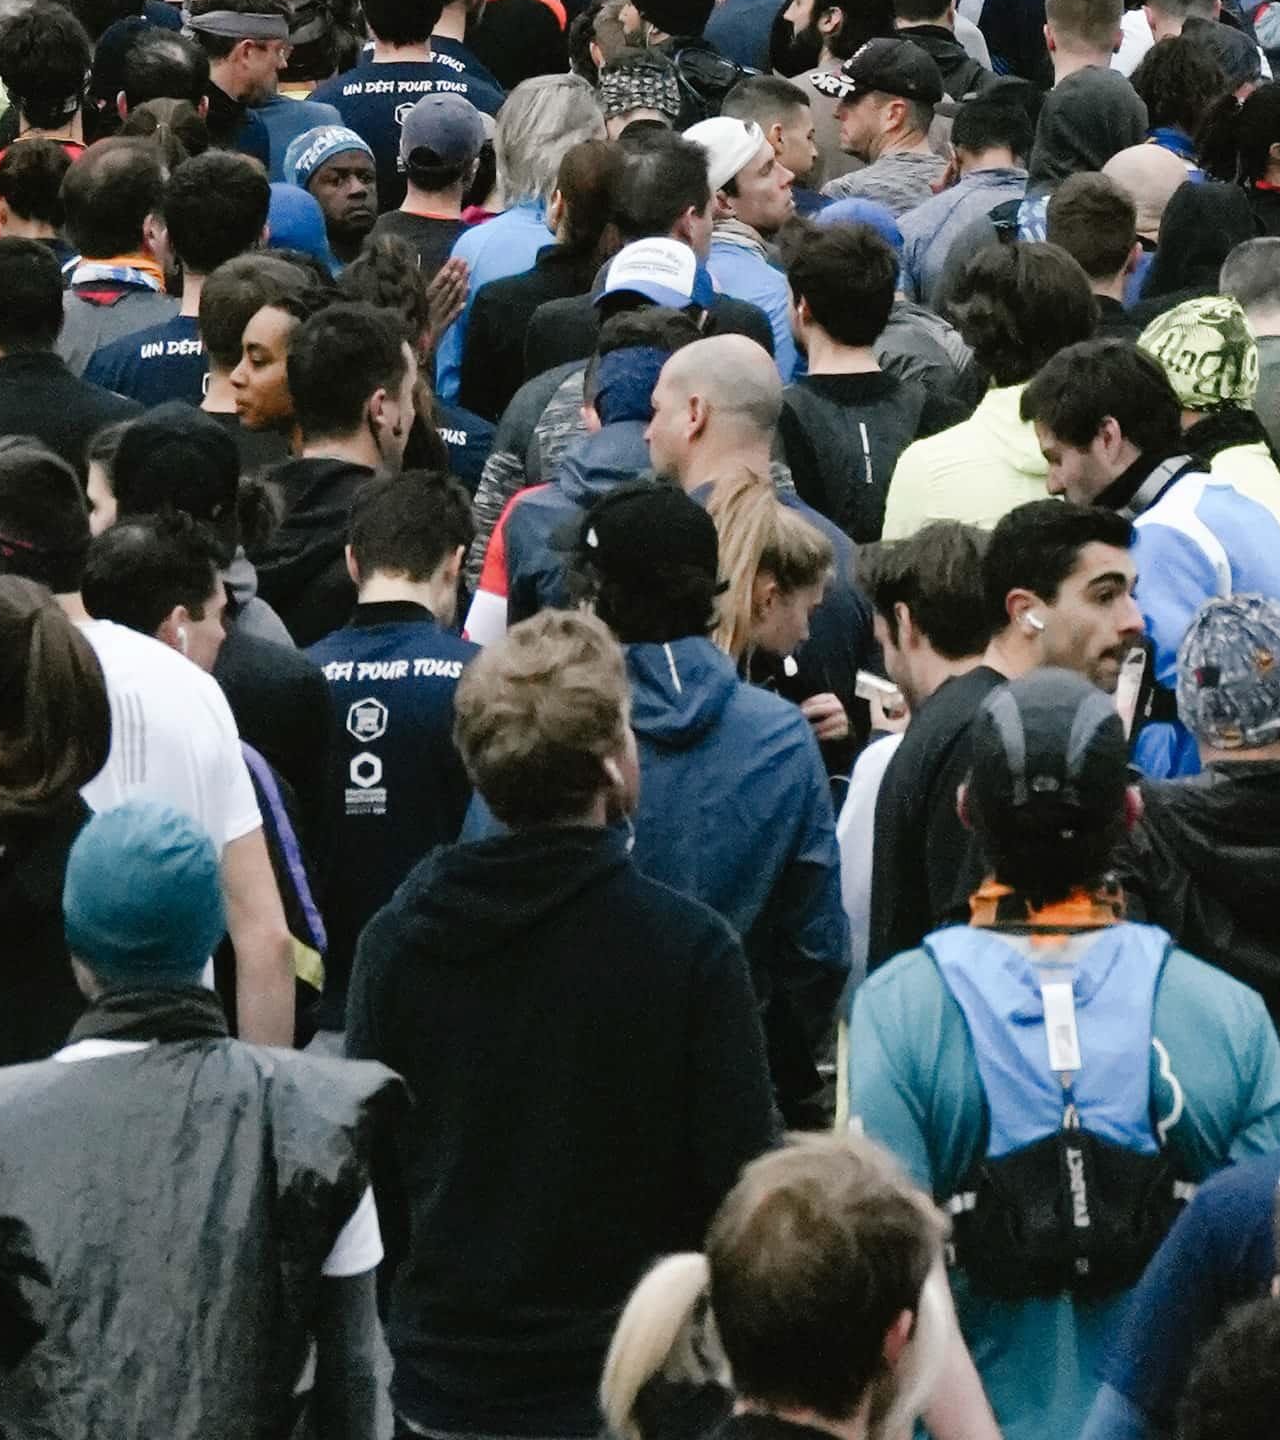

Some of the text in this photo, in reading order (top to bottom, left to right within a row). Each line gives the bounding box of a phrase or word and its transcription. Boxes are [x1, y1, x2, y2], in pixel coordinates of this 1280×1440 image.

[437, 53, 465, 72] TOUS
[342, 79, 468, 96] UN DÉFI POUR TOUS
[141, 339, 202, 359] UN DÉFI
[357, 660, 409, 680] POUR
[413, 657, 463, 679] TOUS
